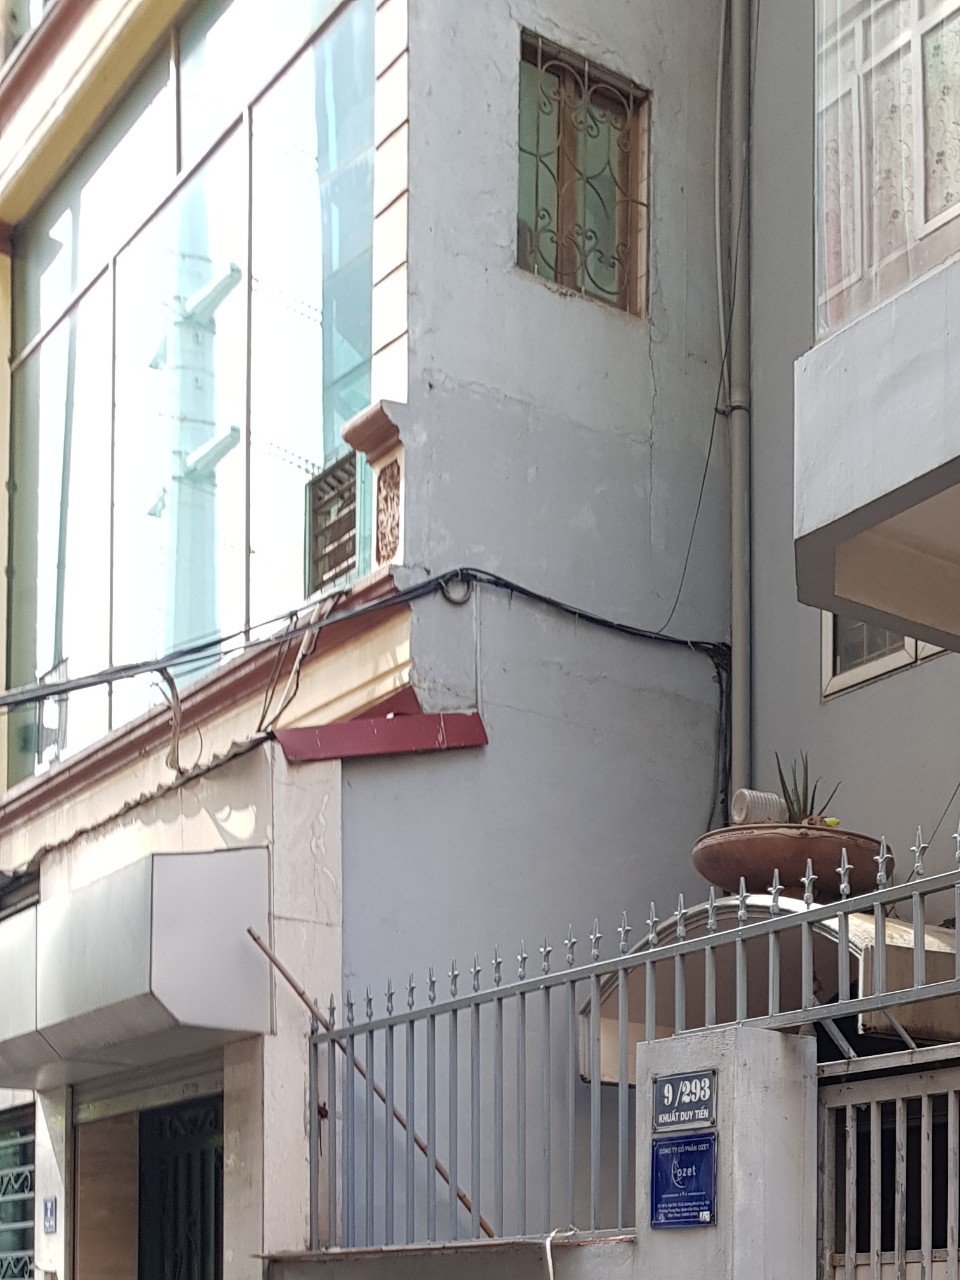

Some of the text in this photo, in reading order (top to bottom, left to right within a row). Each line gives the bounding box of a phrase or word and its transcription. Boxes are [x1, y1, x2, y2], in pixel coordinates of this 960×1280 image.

[658, 1105, 709, 1123] KHUẤT DUY TIẾN
[677, 1164, 697, 1177] ozet
